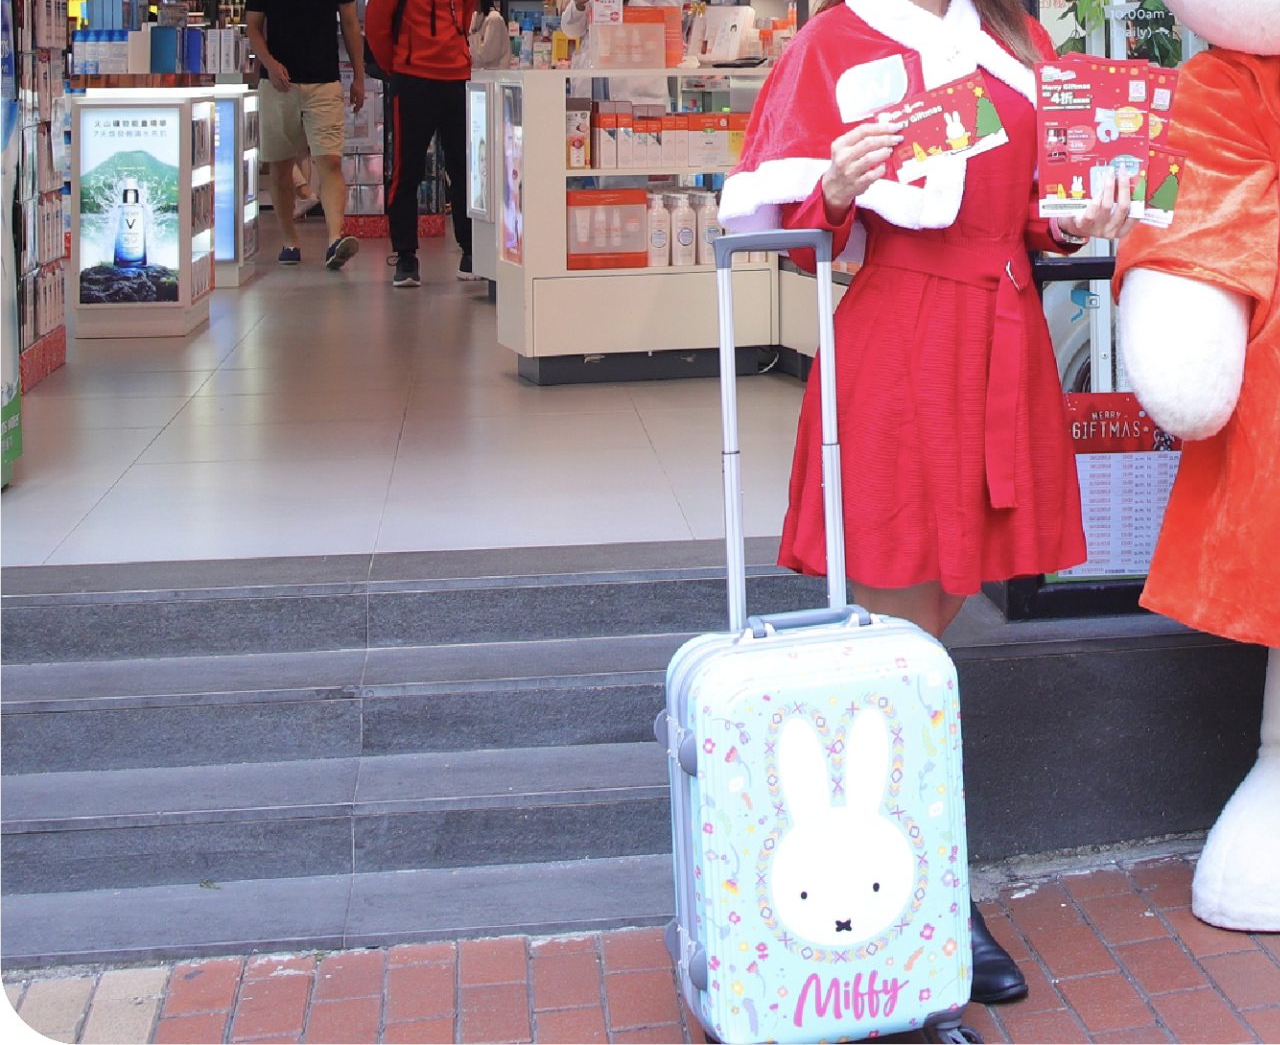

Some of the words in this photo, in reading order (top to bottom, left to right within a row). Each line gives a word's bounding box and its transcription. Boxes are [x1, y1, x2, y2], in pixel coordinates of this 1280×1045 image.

[1091, 410, 1121, 419] MERRY
[1072, 420, 1141, 440] GIFTMAS
[793, 969, 910, 1028] Miffy
